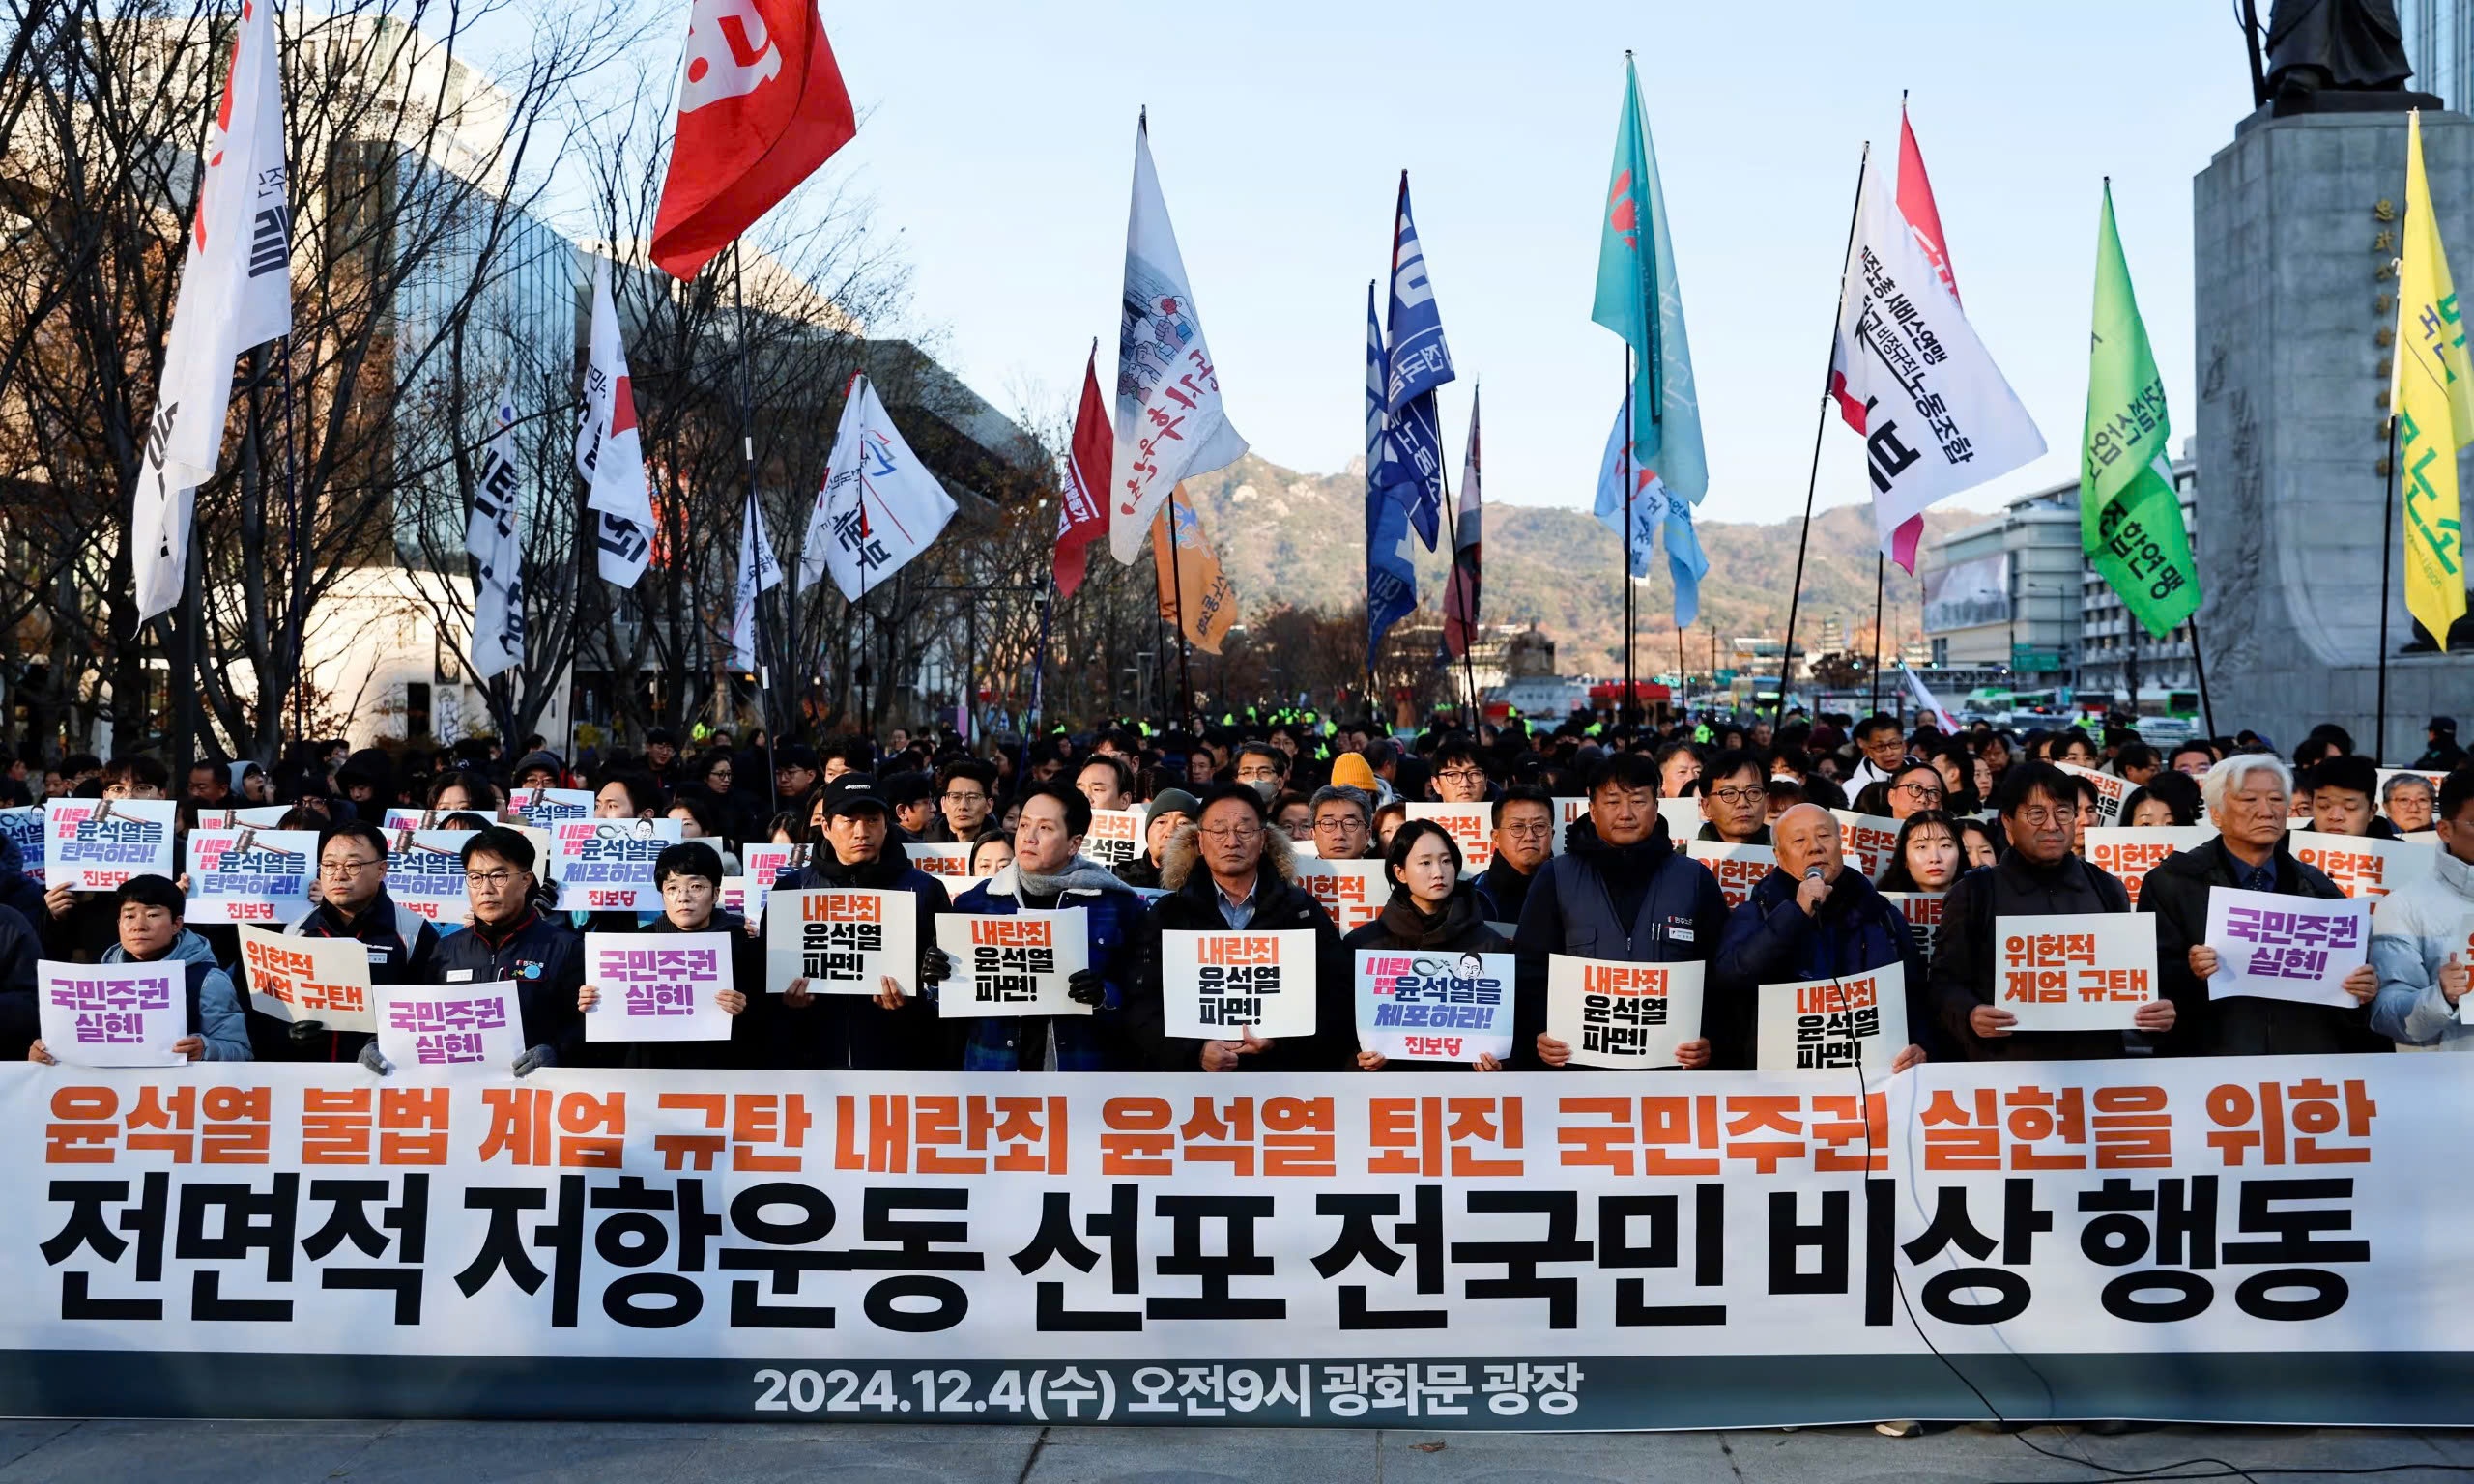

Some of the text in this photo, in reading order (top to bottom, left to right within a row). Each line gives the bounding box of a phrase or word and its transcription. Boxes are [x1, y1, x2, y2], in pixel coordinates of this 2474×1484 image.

[1884, 294, 1948, 366] 서비스연맹
[53, 807, 91, 823] 내란
[76, 820, 163, 842] 윤석열을
[559, 824, 596, 840] 내란
[59, 842, 157, 863] 탄핵하라!
[193, 839, 232, 854] 내란
[582, 839, 670, 862] 윤석열을
[219, 851, 306, 874] 윤석열을
[750, 854, 786, 869] 내란
[203, 873, 301, 895] 탄핵하라!
[588, 889, 637, 906] 진보당
[226, 902, 275, 919] 진보당
[802, 895, 881, 923] 내란죄
[803, 924, 881, 951] 윤석열
[971, 920, 1051, 948] 내란죄
[2226, 905, 2358, 950] 국민주권
[246, 940, 315, 980] 위헌적
[974, 947, 1054, 974] 윤석열
[1197, 936, 1279, 964] 내란죄
[2005, 933, 2095, 967] 위헌적
[2247, 947, 2329, 981] 실현!
[598, 949, 718, 982] 국민주권
[803, 953, 864, 981] 파면!
[1199, 966, 1280, 994] 윤석열
[1366, 956, 1411, 975] 내란
[1584, 964, 1668, 996] 내란죄
[50, 977, 170, 1010] 국민주권
[251, 966, 365, 1013] 계엄 규탄!
[625, 983, 694, 1015] 실현!
[975, 975, 1038, 1003] 파면!
[1395, 975, 1502, 1005] 윤석열을
[1797, 977, 1877, 1013] 내란죄
[2005, 970, 2148, 1003] 계엄 규탄!
[389, 997, 505, 1032] 국민주권
[1199, 997, 1262, 1026] 파면!
[1373, 1004, 1493, 1030] 체포하라!
[1584, 995, 1667, 1025] 윤석열
[1797, 1007, 1880, 1041] 윤석열
[75, 1013, 144, 1043] 실현!
[1583, 1025, 1647, 1055] 파면!
[416, 1033, 484, 1064] 실현!
[1404, 1036, 1463, 1056] 진보당
[1797, 1041, 1861, 1070] 파면!
[45, 1077, 2377, 1176] 윤석열 불법 계엄 규탄 내란죄 윤석열 퇴진 국민주권 실현을 위한
[39, 1172, 2371, 1333] 전면적 저항운동 선포 전국민 비상 행동
[754, 1363, 1583, 1421] 2024.12.4(수) 오전9시 광화문 광장
